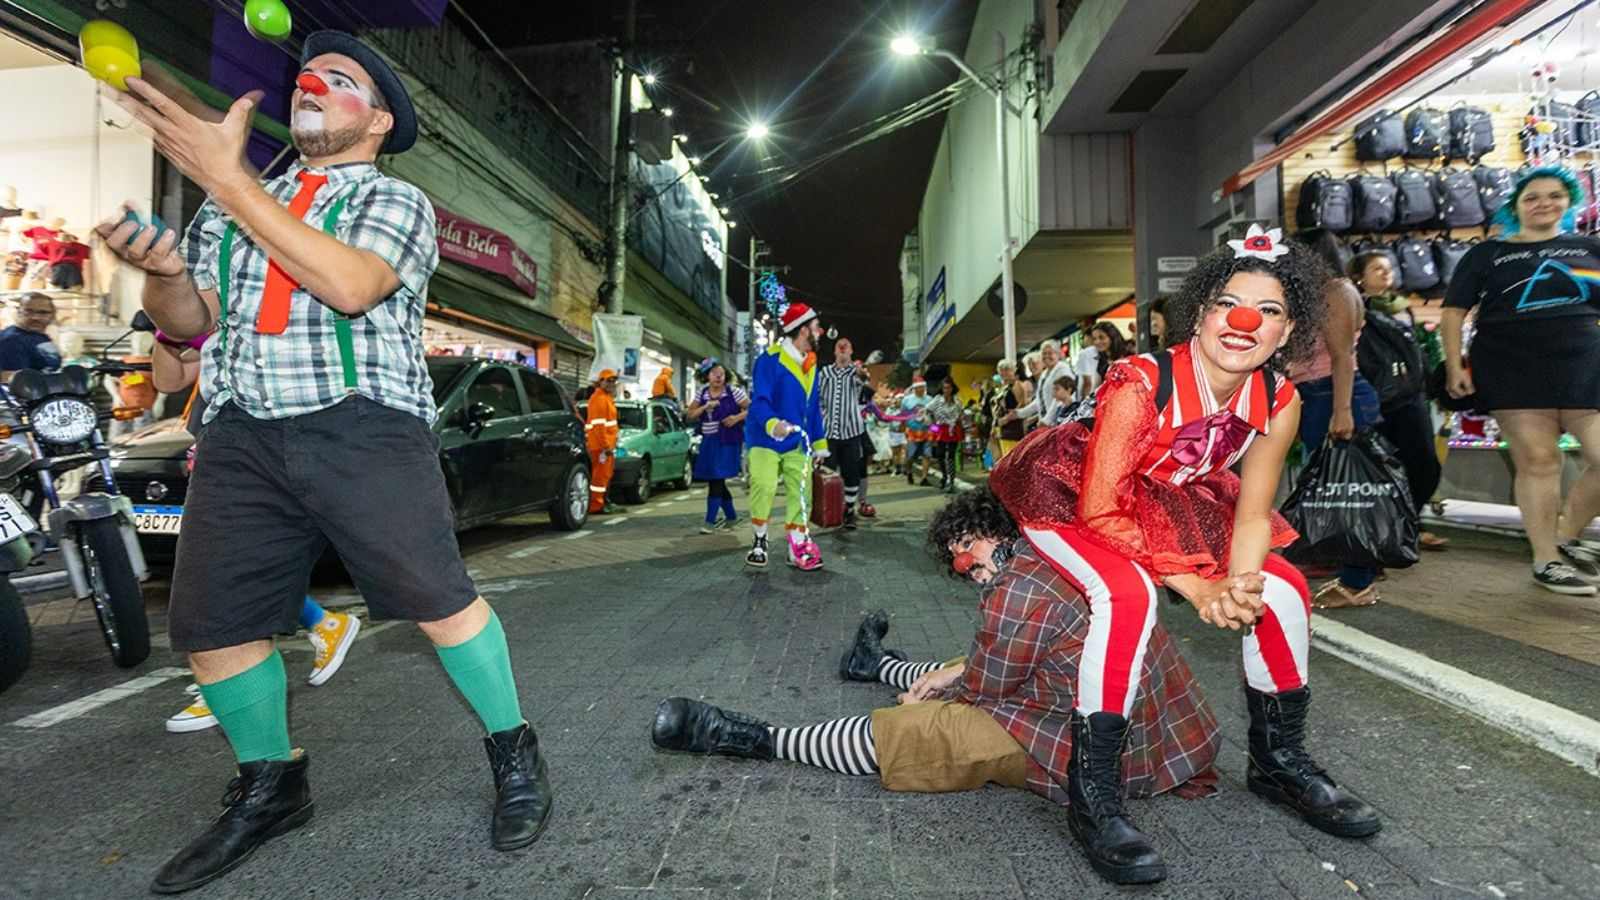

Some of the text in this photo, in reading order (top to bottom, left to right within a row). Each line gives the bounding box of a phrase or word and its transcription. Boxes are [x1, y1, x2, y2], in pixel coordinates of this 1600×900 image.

[436, 218, 499, 257] ida Bela
[135, 514, 180, 530] C8C77
